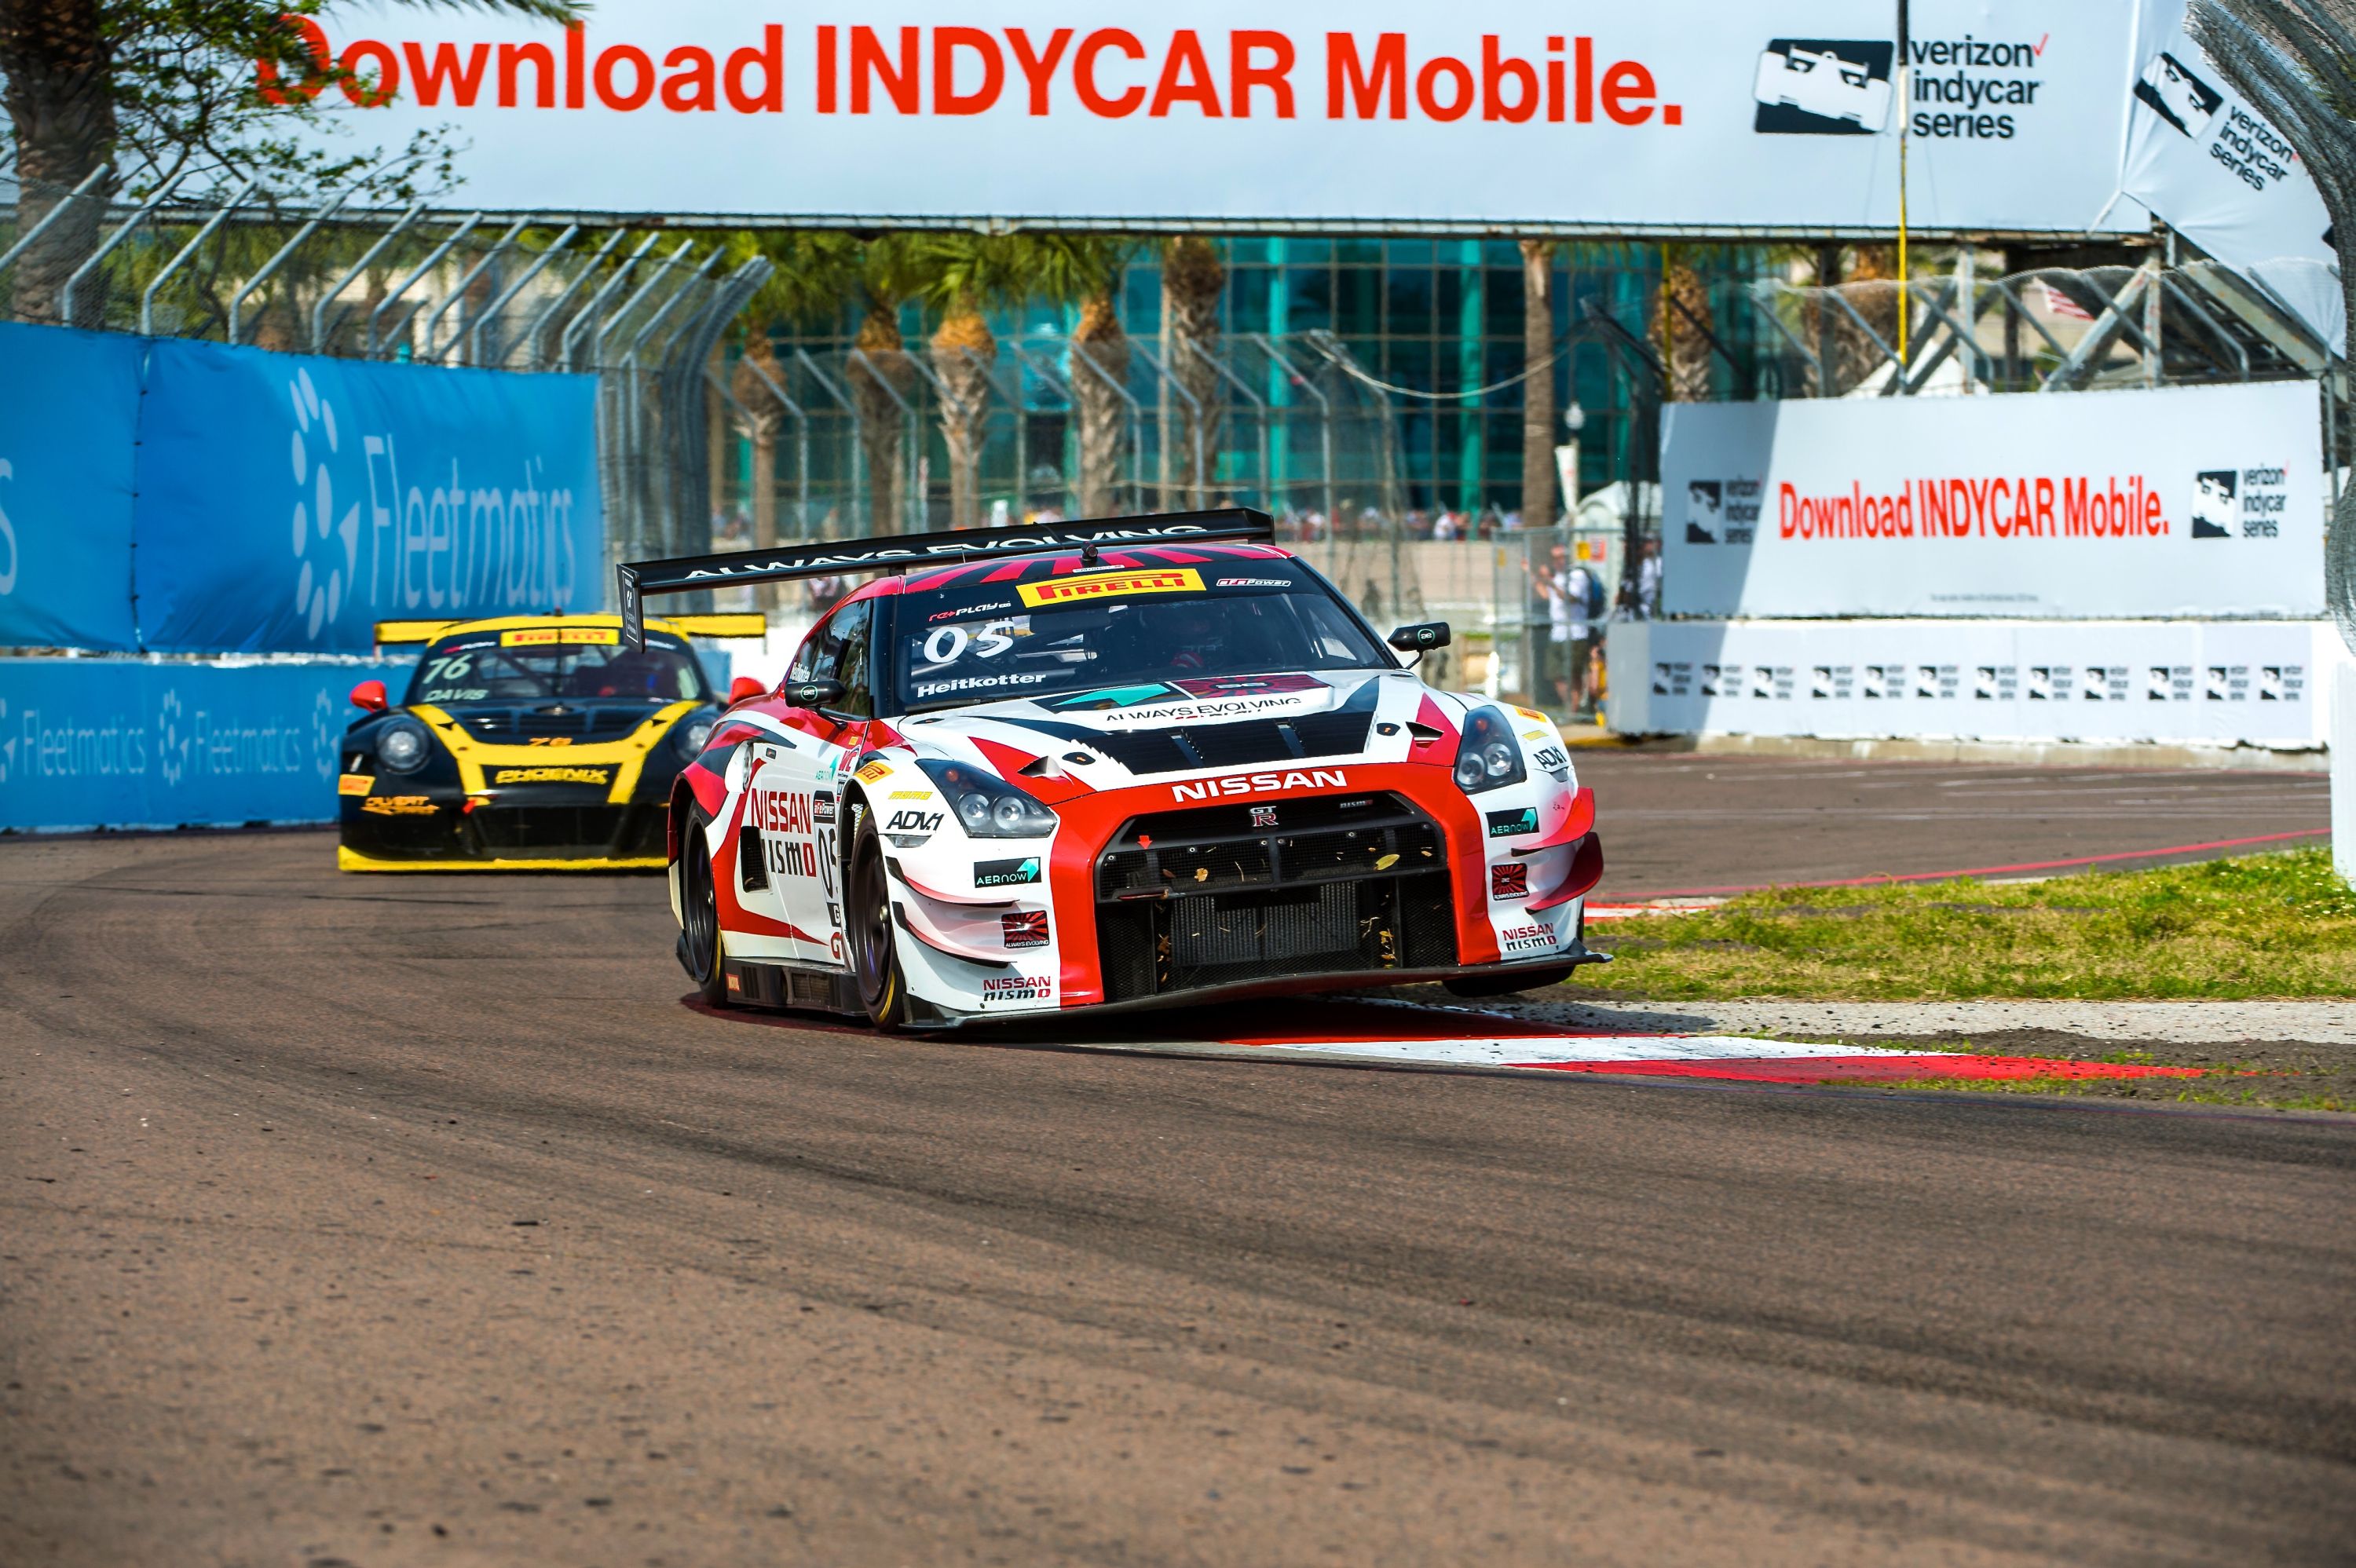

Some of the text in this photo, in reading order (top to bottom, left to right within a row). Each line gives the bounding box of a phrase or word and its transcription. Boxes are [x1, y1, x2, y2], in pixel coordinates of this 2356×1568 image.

[257, 13, 1683, 126] Download INDYCAR Mobile.
[1910, 34, 2033, 68] verizon
[1914, 69, 2040, 110] indycar
[1912, 112, 2015, 139] series
[2230, 105, 2293, 163] verizon
[2209, 142, 2266, 191] series
[2219, 121, 2288, 181] indycar
[2241, 463, 2285, 486] verizon
[363, 432, 575, 609] Fleetmatics
[1779, 475, 2171, 540] Download INDYCAR Mobile.
[2242, 491, 2287, 517] indycar
[1036, 572, 1183, 600] PIRELLI
[923, 620, 1015, 663] 05
[916, 673, 1046, 698] Heitkotter
[23, 709, 146, 777] Fleetmatics
[195, 711, 302, 774] Fleetmatics
[1172, 770, 1348, 803] NISSAN
[751, 788, 812, 834] NISSAN
[1502, 923, 1554, 941] NISSAN
[1506, 935, 1557, 951] nismo
[983, 976, 1052, 990] NISSAN
[983, 988, 1051, 1001] nismo
